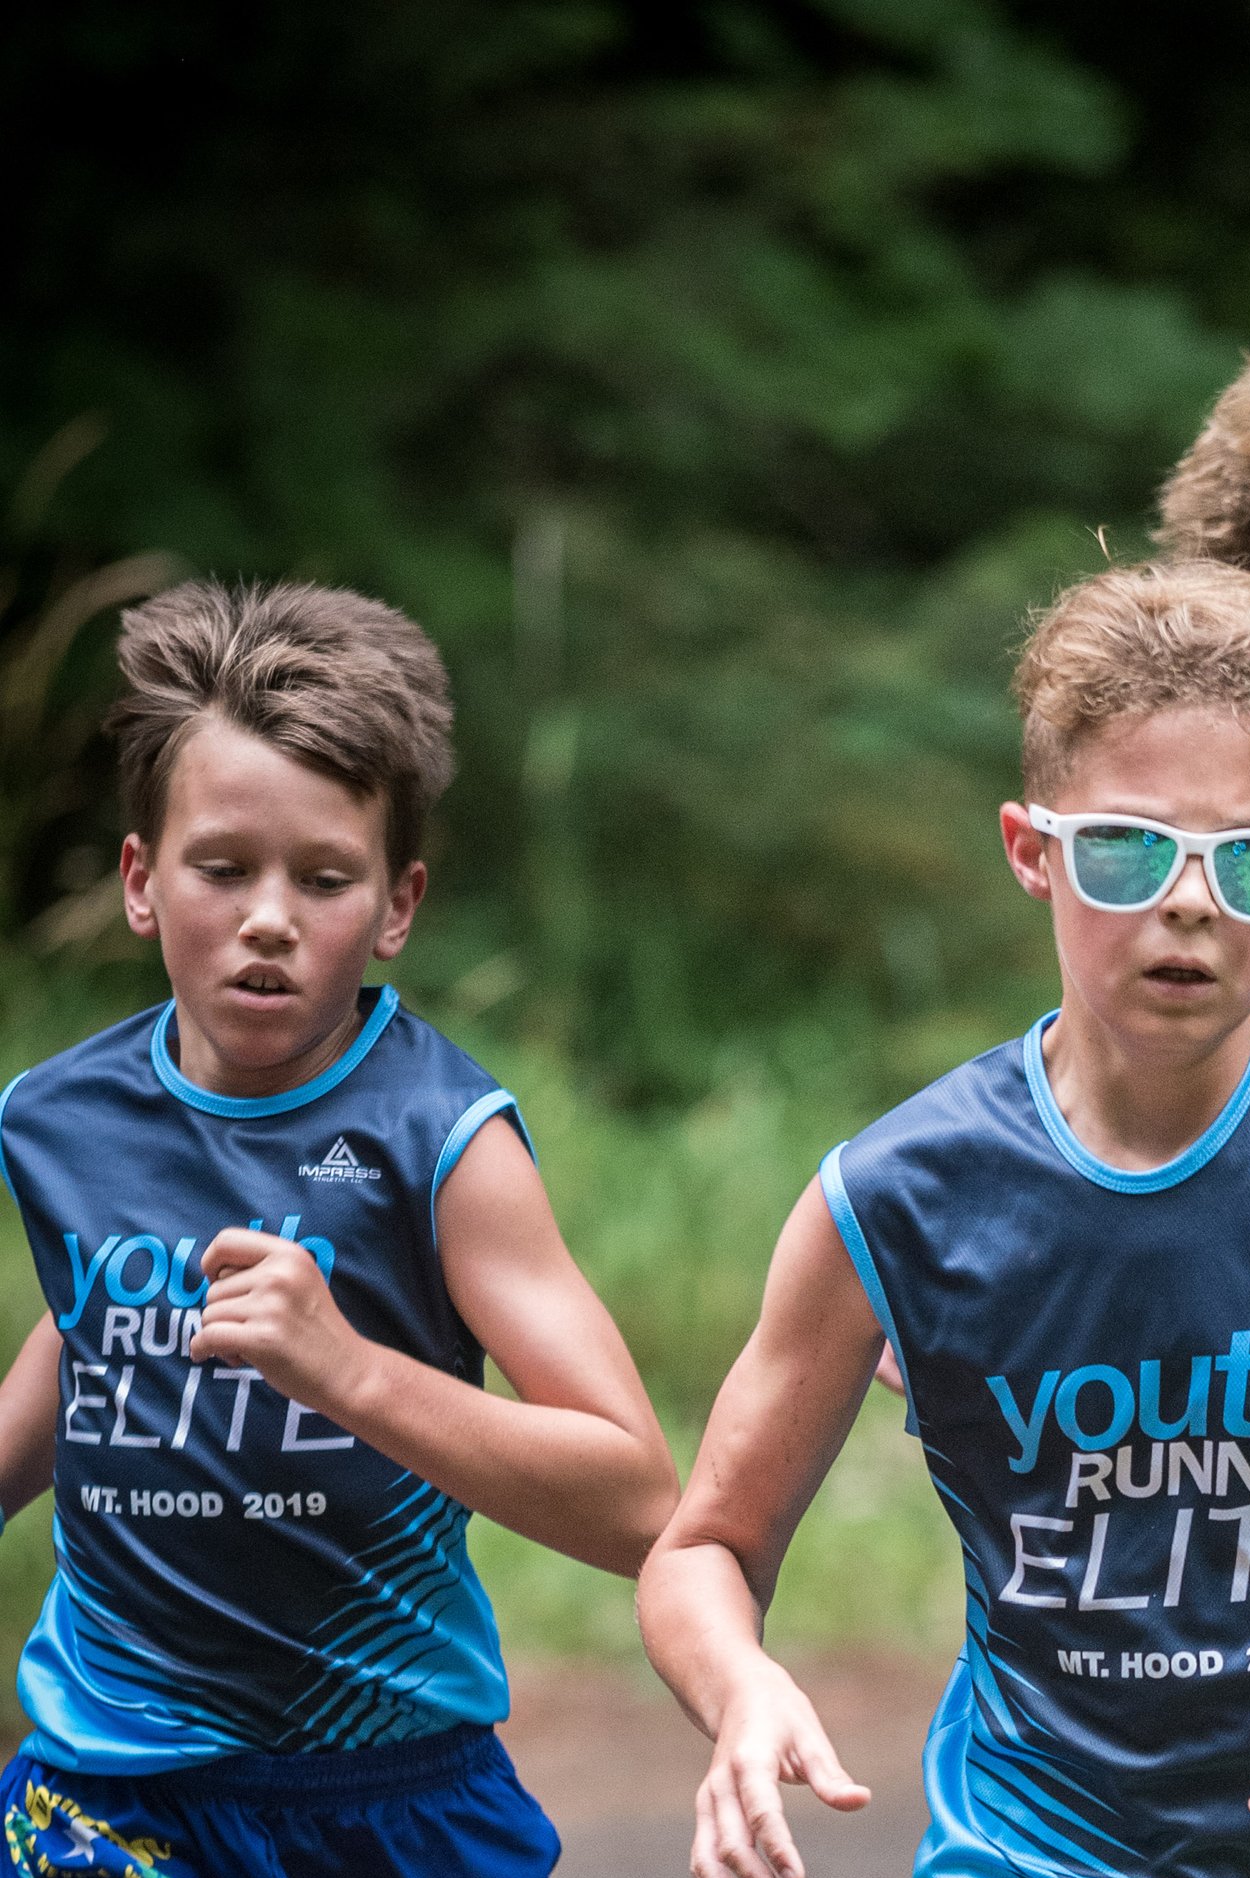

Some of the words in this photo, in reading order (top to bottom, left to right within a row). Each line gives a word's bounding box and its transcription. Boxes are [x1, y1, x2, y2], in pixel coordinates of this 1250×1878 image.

[298, 1165, 382, 1179] IMPRESS
[65, 1360, 355, 1452] ELITE
[81, 1485, 122, 1514] MT.
[130, 1489, 223, 1517] HOOD
[243, 1491, 327, 1519] 2019
[1057, 1650, 1110, 1678] MT.
[1121, 1650, 1224, 1679] HOOD
